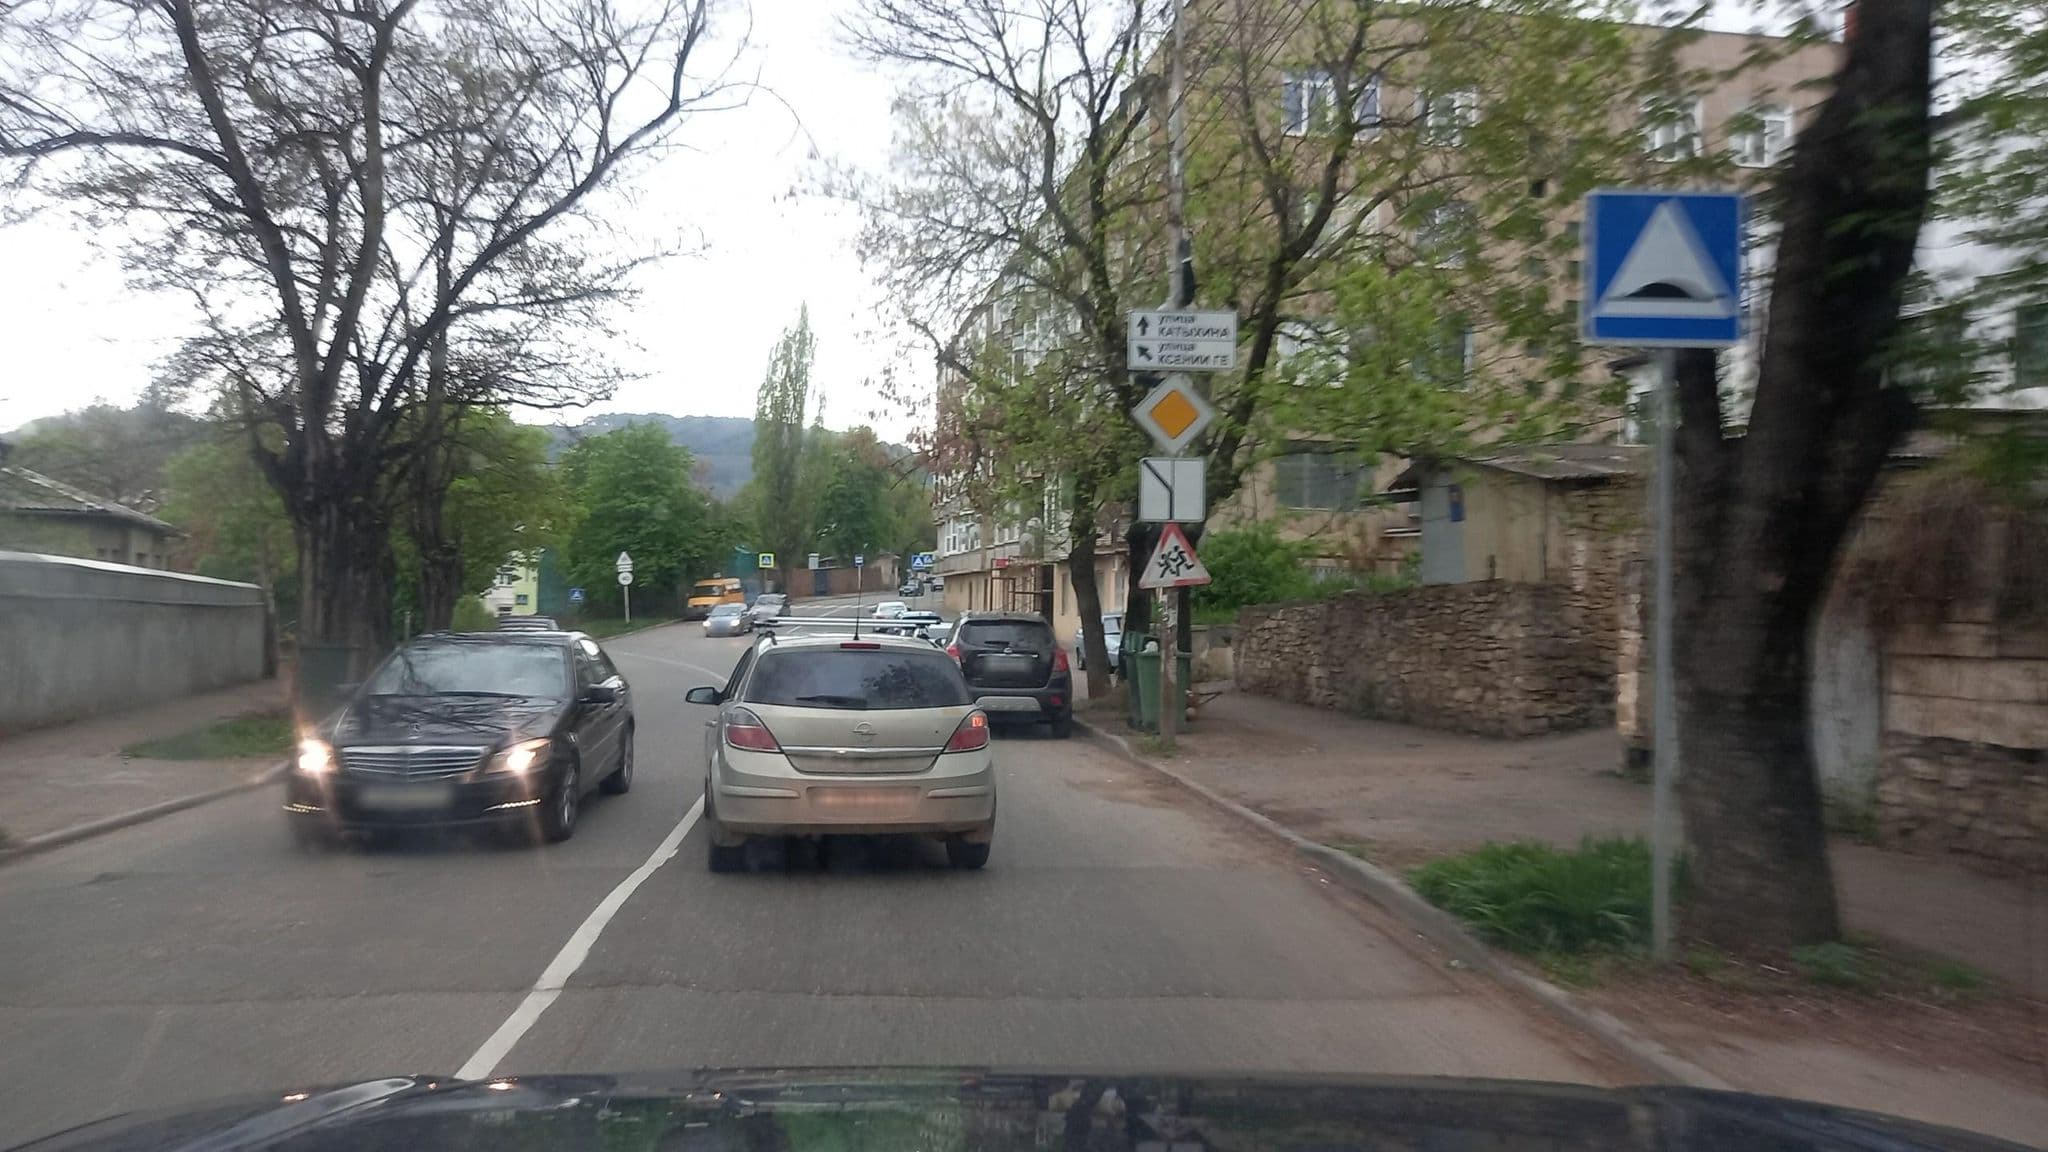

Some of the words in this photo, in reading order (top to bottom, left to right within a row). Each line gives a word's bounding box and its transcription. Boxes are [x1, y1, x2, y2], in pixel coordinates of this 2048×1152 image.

[1158, 315, 1195, 325] улица
[1158, 343, 1195, 353] улица
[1158, 355, 1209, 365] КСЕНИИ
[1213, 355, 1228, 365] ГЕ
